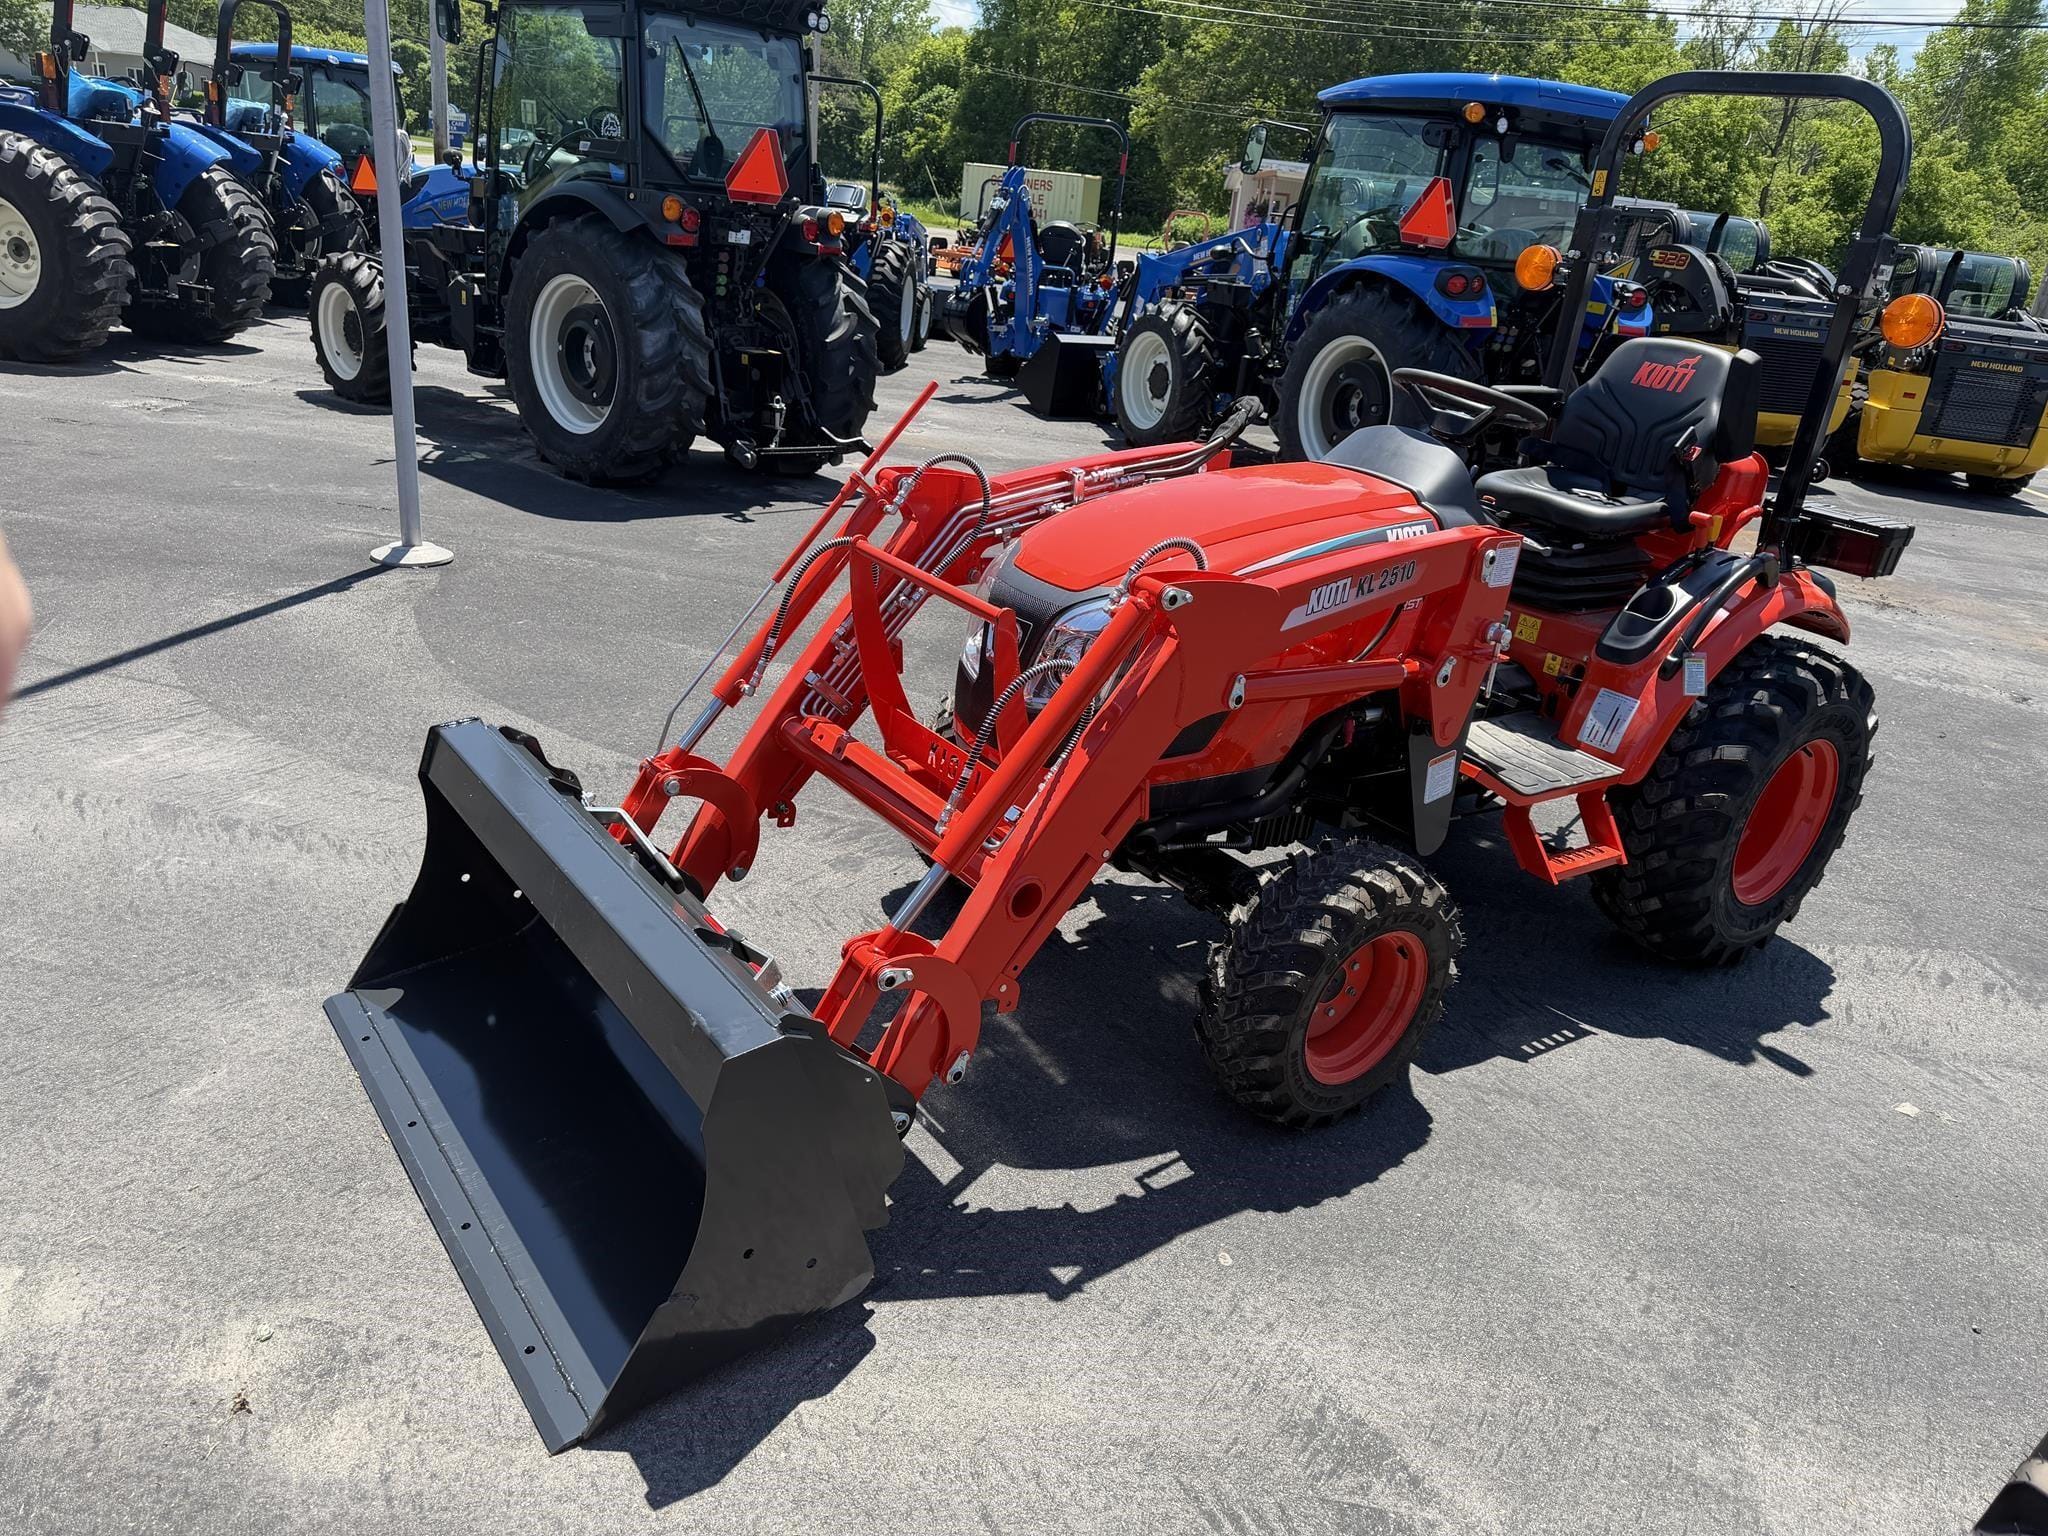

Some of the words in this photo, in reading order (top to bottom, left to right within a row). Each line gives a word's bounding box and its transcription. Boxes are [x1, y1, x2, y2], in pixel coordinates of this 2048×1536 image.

[1774, 327, 1789, 335] NEW
[1790, 328, 1819, 338] HOLLAND
[1631, 361, 1696, 393] KIOTI
[1970, 360, 1989, 368] NEW
[1989, 362, 2024, 373] HOLLAND
[1305, 577, 1352, 616] KIOTI
[1356, 574, 1375, 599] KL
[1379, 560, 1416, 591] 2510
